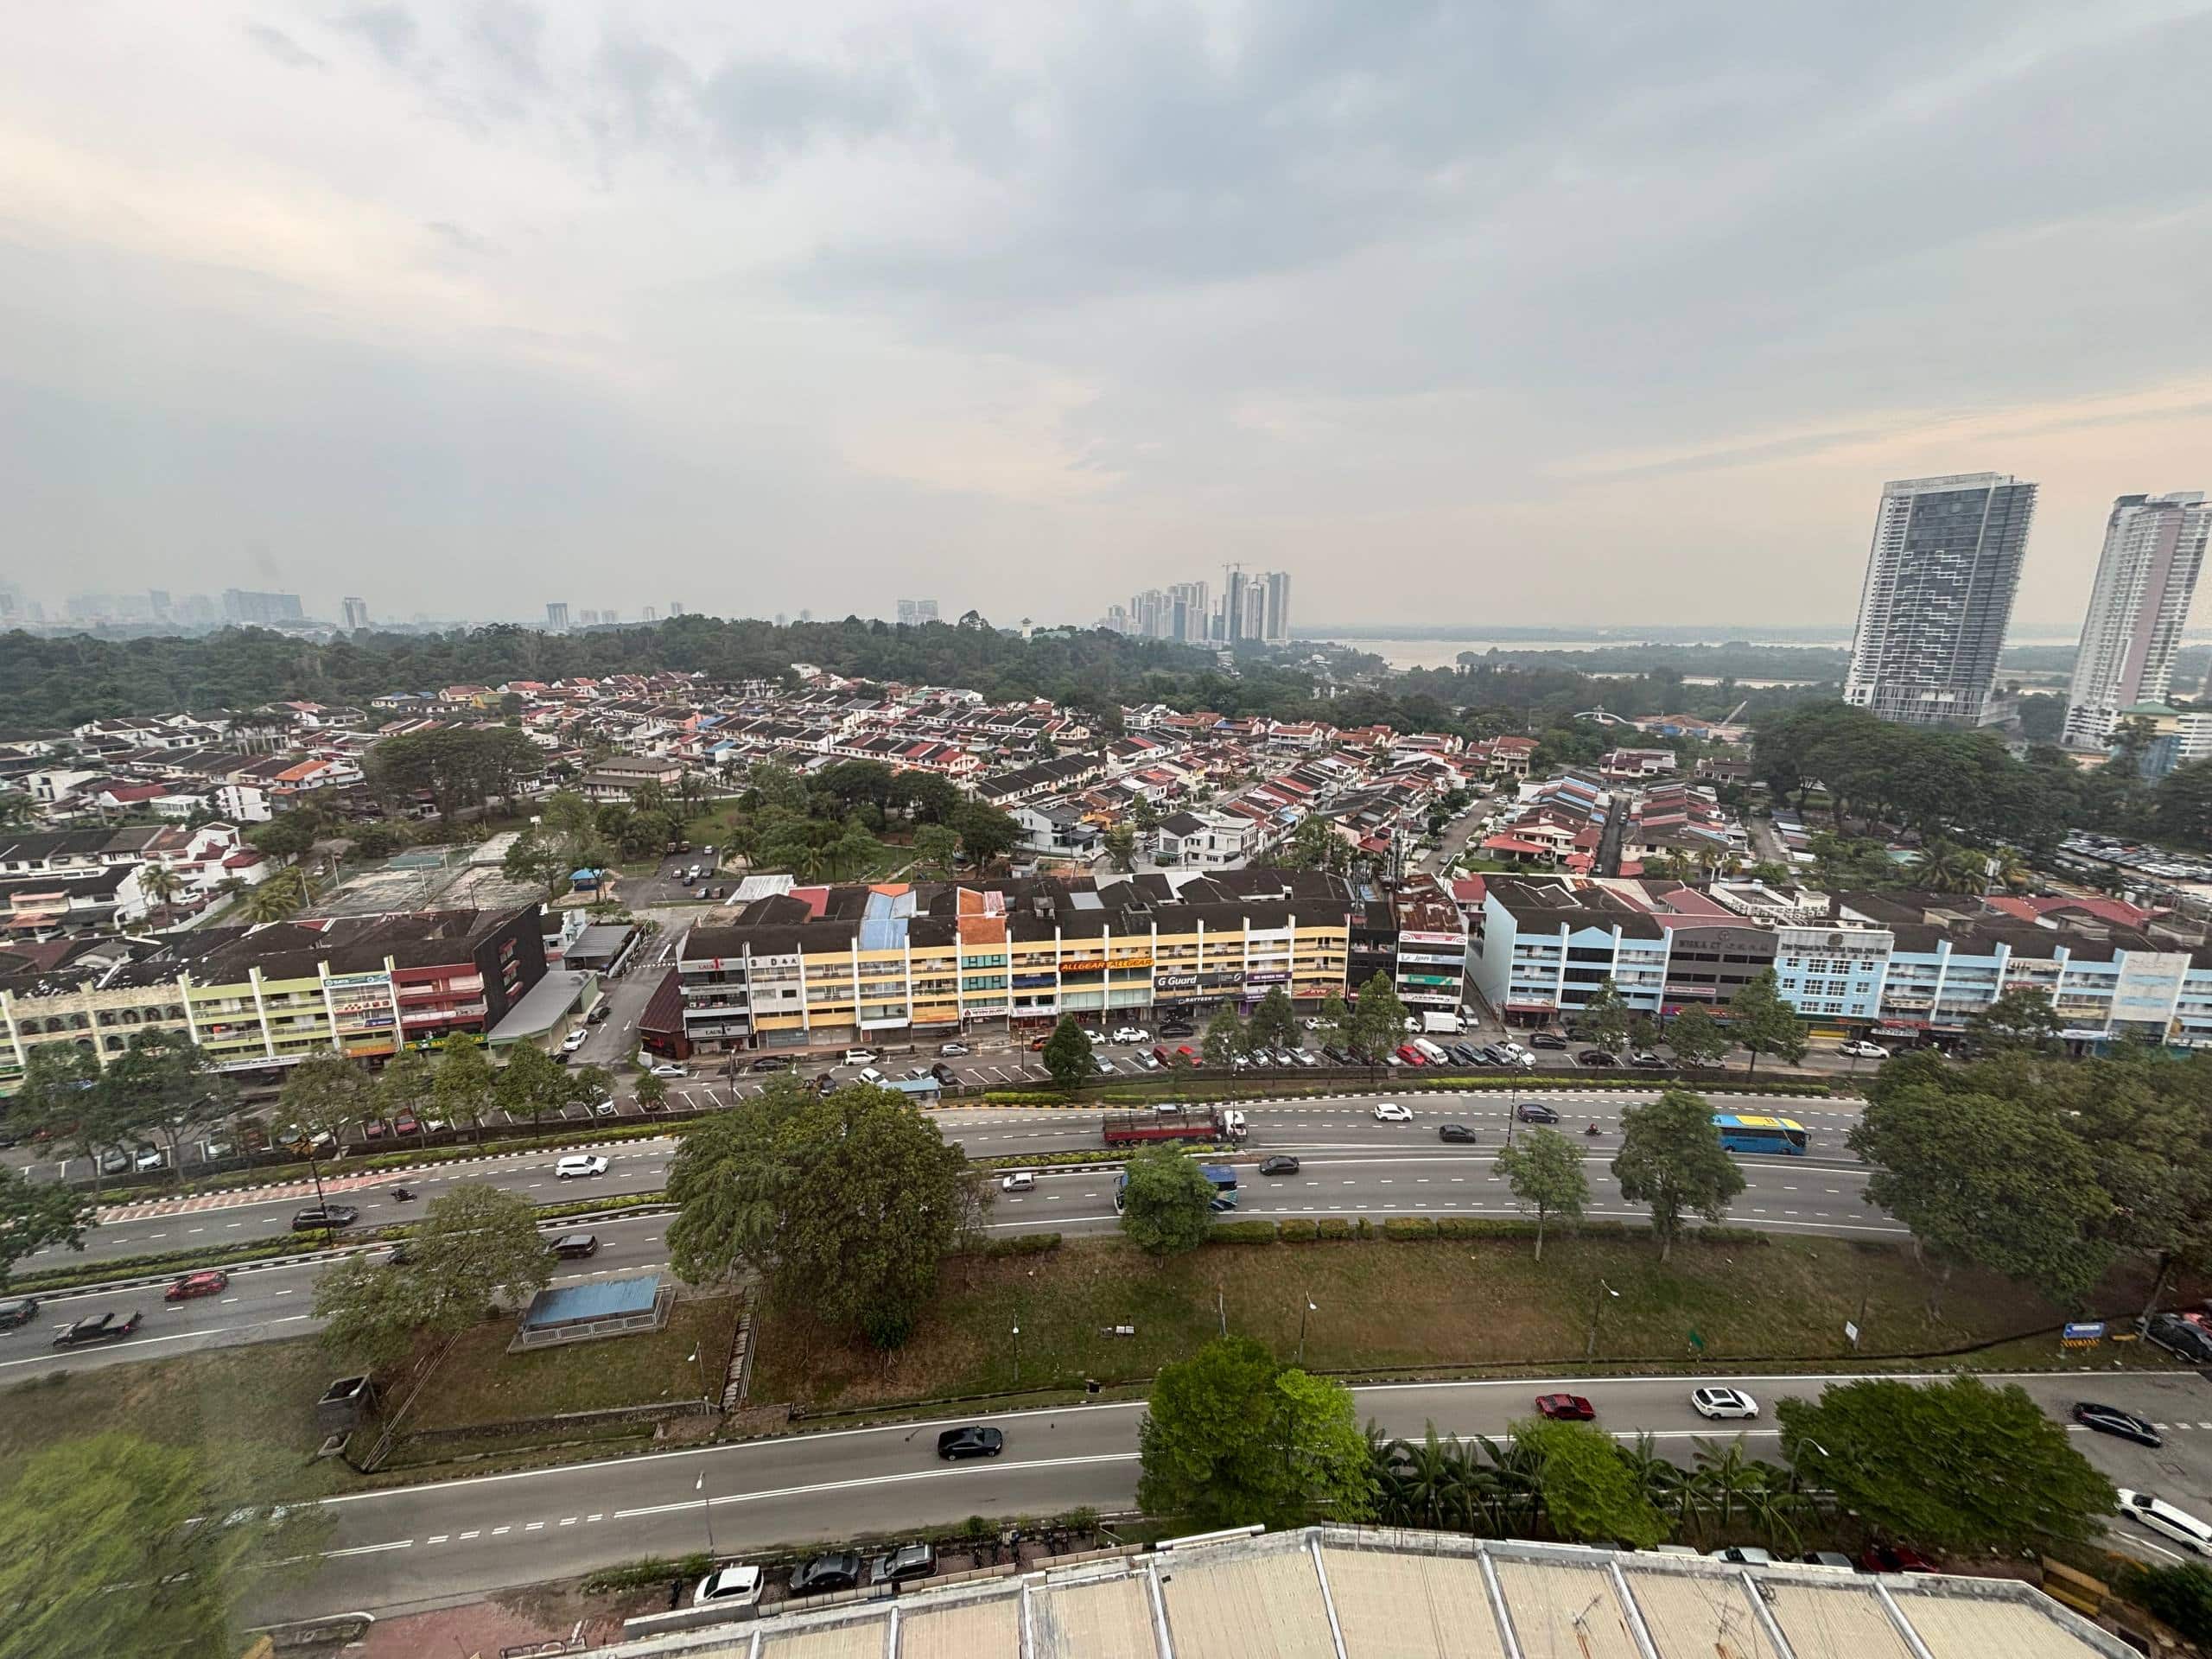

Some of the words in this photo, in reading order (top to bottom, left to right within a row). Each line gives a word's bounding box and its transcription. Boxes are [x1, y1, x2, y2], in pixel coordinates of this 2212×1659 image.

[1061, 962, 1107, 970] ALLGEAR
[1109, 959, 1153, 969] ALLGEAR
[1158, 977, 1166, 986] G
[1167, 975, 1197, 986] Guard
